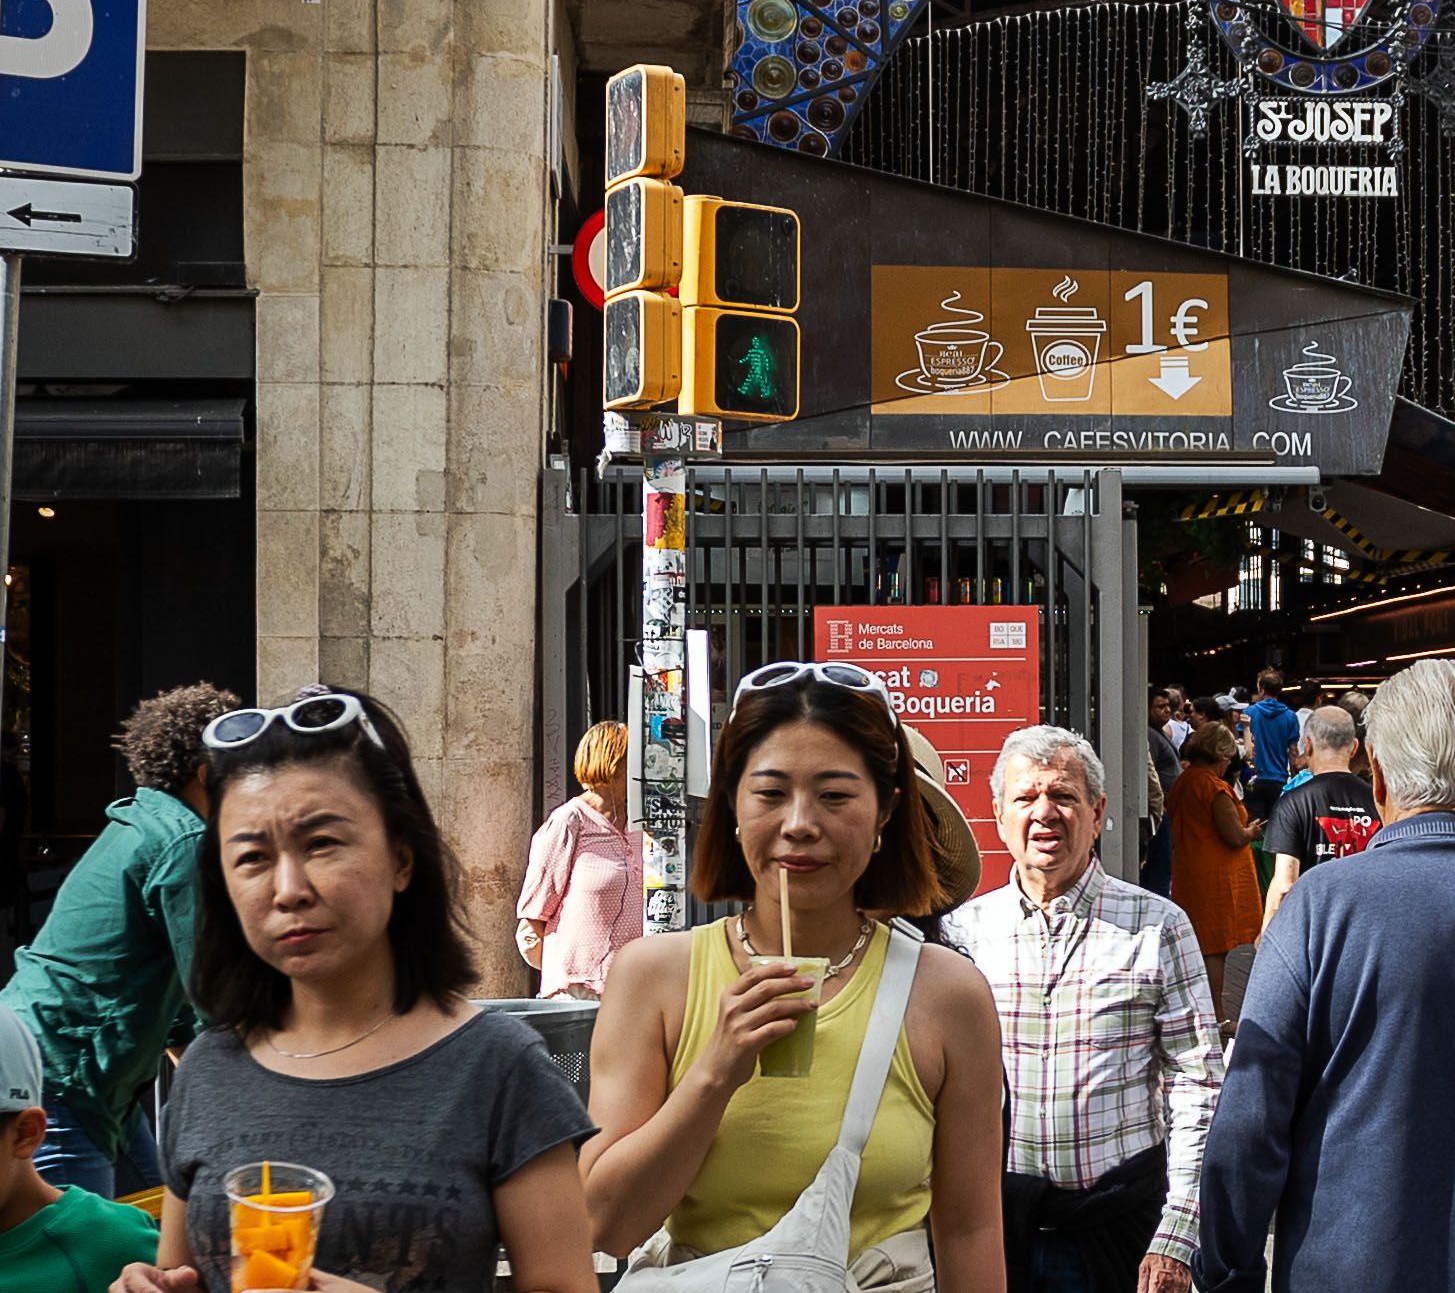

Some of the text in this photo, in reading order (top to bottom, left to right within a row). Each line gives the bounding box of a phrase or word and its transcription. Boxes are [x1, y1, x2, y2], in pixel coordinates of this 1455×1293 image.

[1287, 101, 1393, 142] JOSEP
[1250, 164, 1399, 196] LA BOQUERIA
[1125, 280, 1209, 354] 1€
[1048, 354, 1084, 366] Coffee
[858, 622, 904, 635] Mercats
[858, 637, 934, 650] de Barcelona
[890, 690, 995, 719] Boqueria
[9, 1088, 30, 1100] FILA
